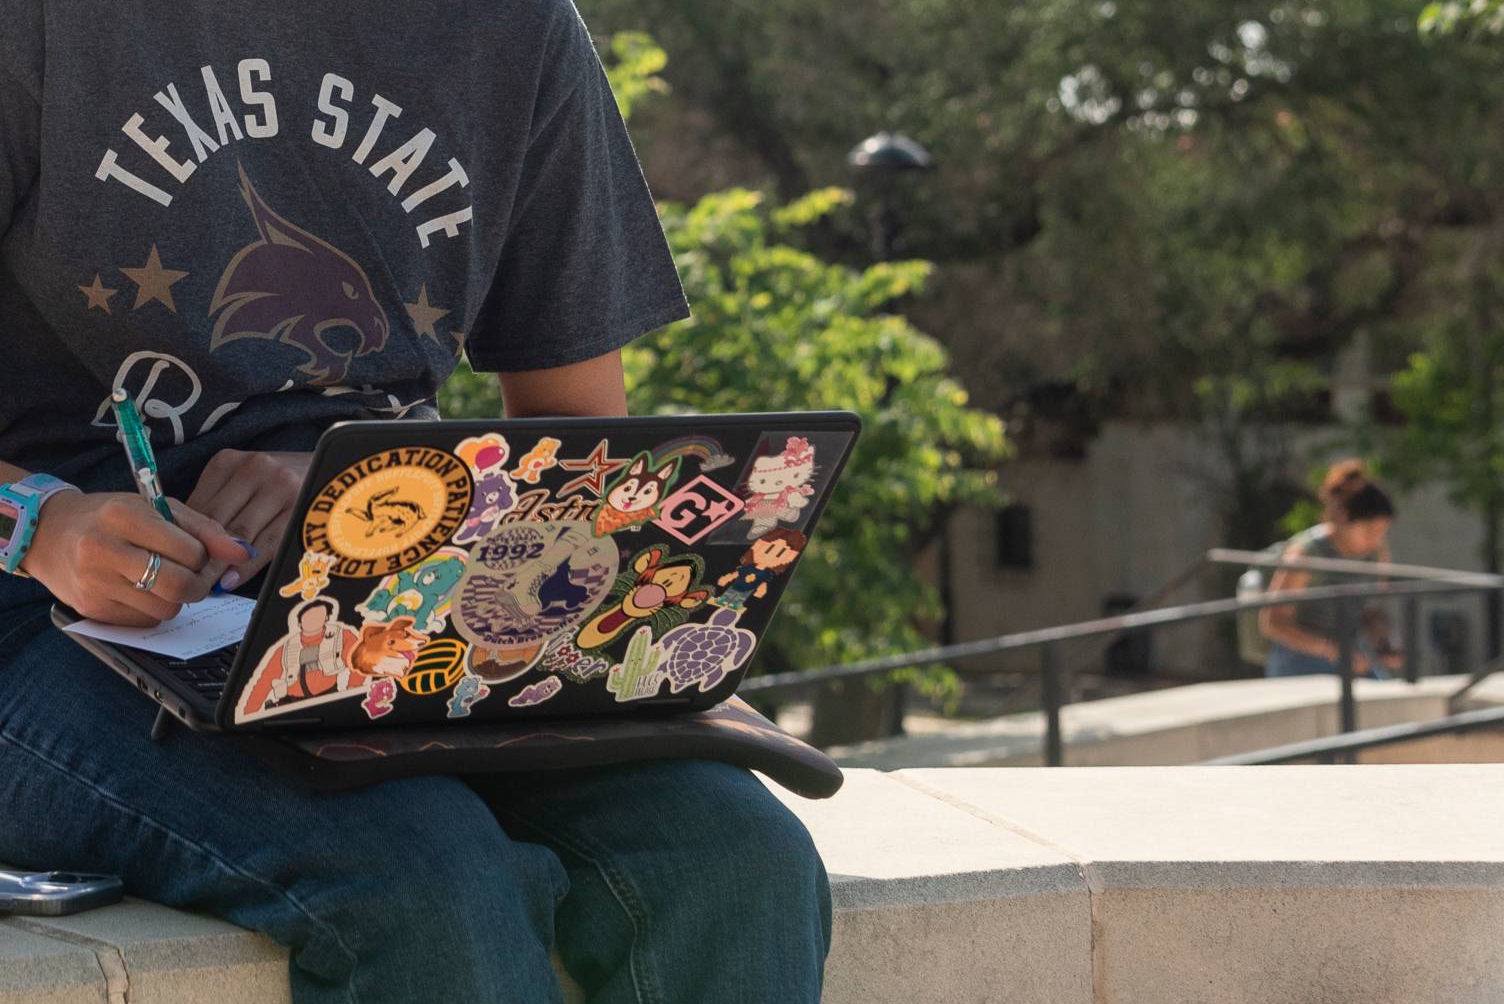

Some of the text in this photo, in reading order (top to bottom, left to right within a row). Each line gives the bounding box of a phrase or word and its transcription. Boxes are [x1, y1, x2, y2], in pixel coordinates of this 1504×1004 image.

[95, 58, 474, 250] TEXAS STATE
[312, 449, 461, 514] DEDICATION
[386, 478, 469, 573] PATIENCE
[476, 541, 546, 563] 1992
